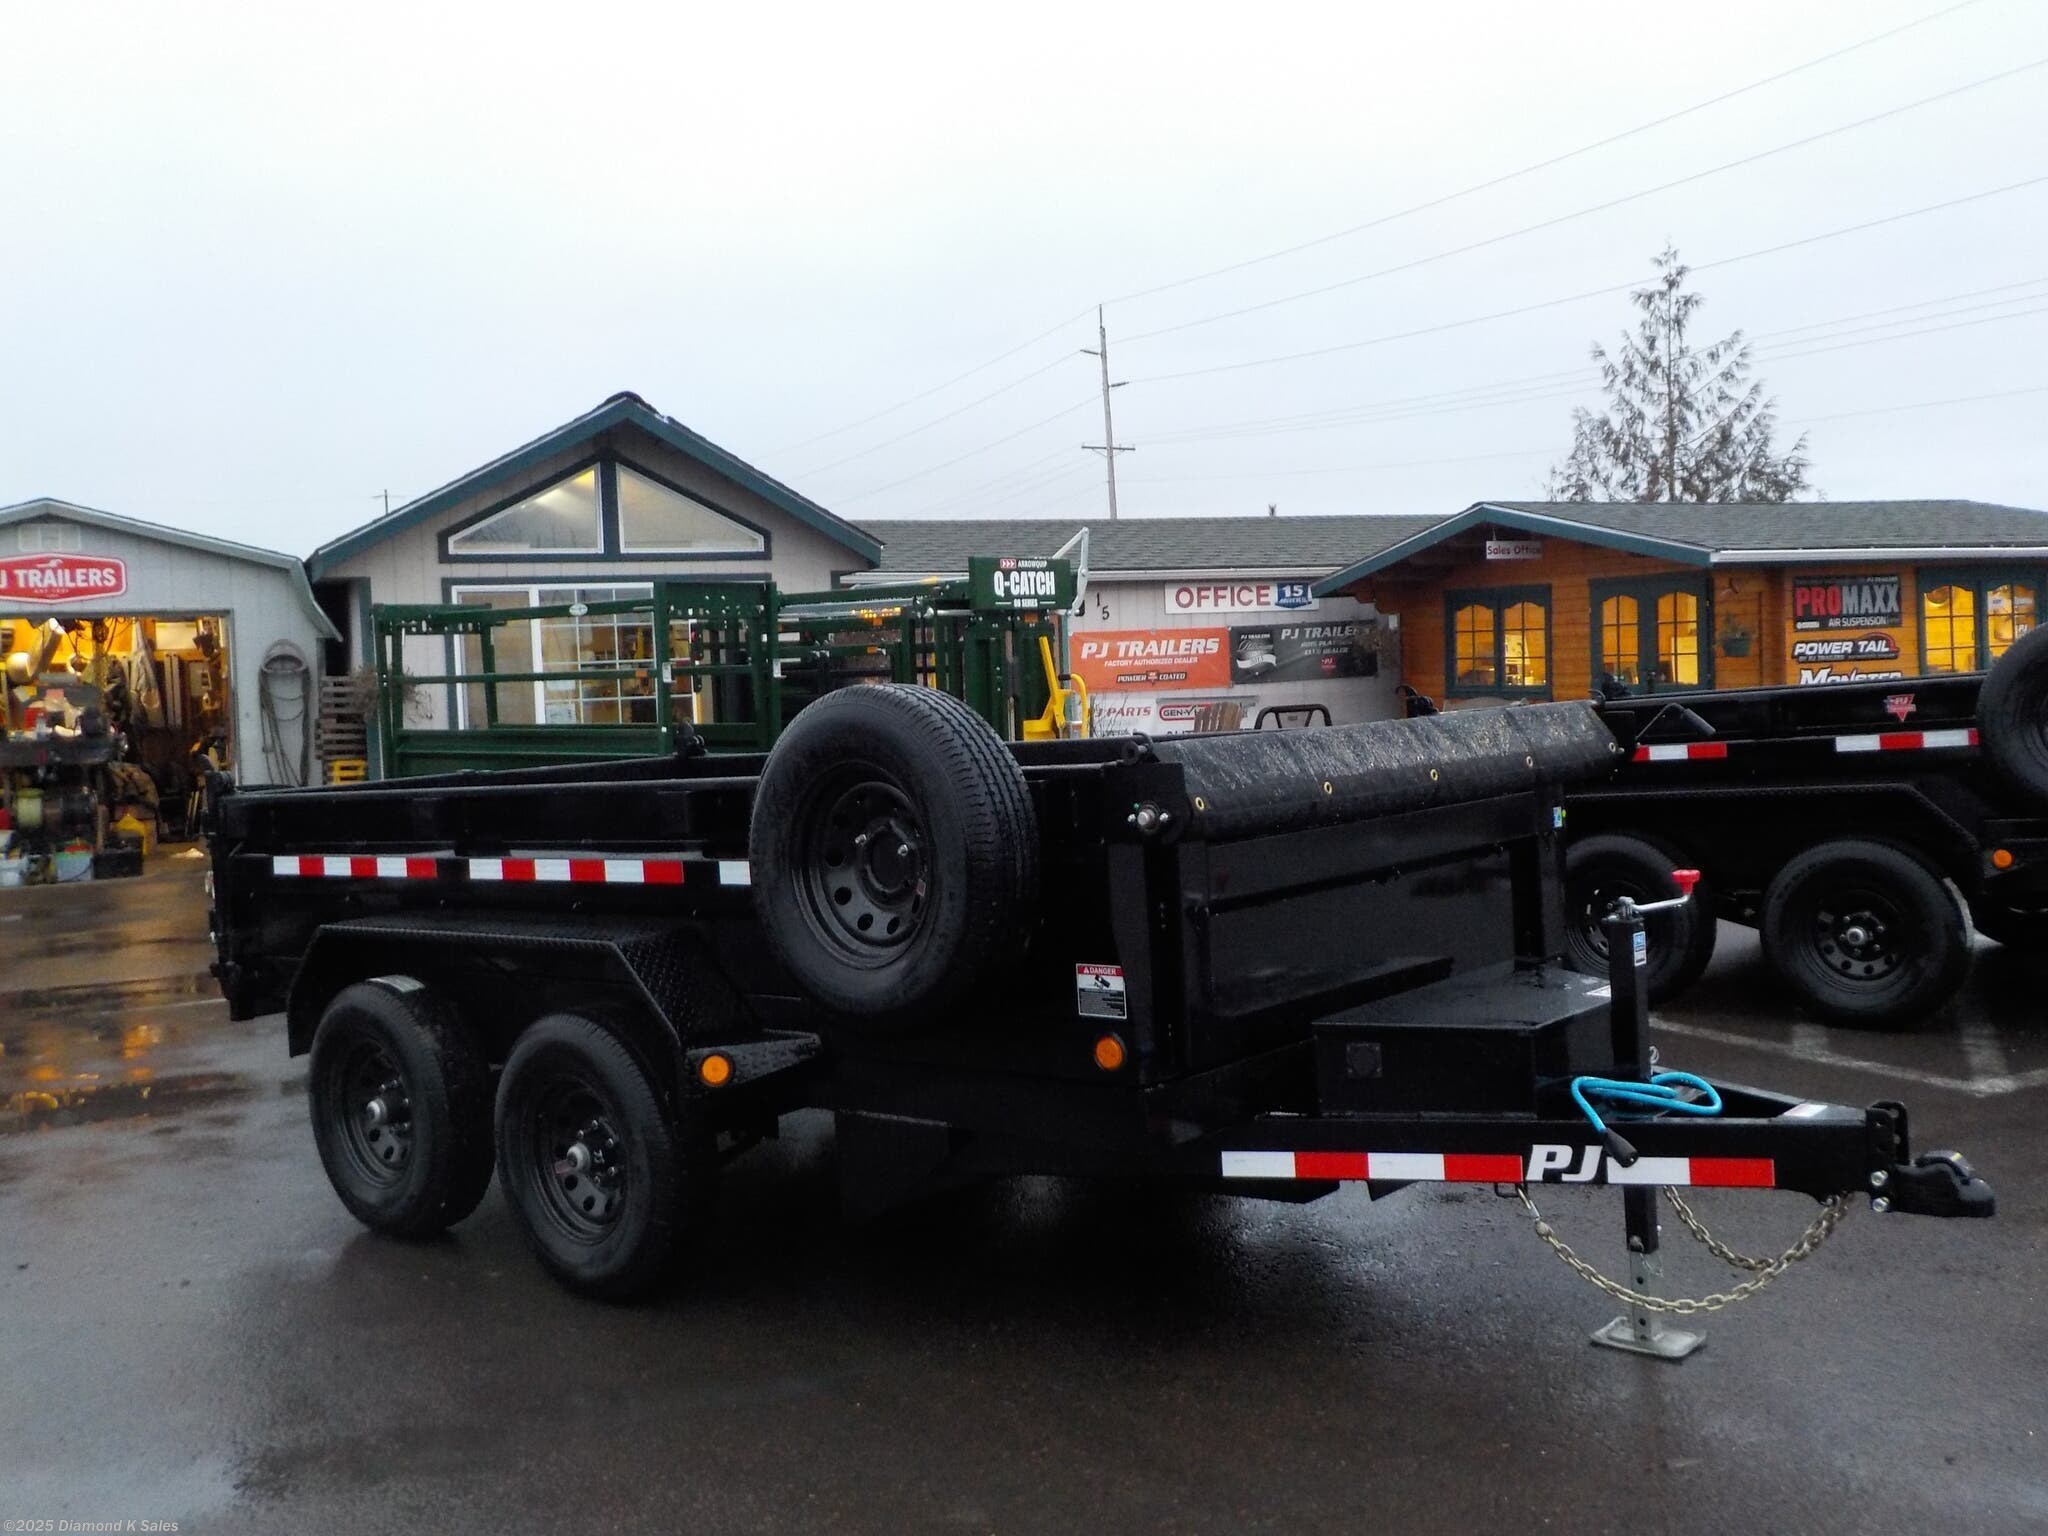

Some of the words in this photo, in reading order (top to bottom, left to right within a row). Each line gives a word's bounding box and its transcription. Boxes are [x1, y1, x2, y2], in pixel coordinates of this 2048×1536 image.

[1487, 545, 1511, 555] Sales
[14, 567, 116, 588] TRAILERS
[993, 571, 1056, 597] Q-CATCH
[1175, 585, 1271, 609] OFFICE
[1282, 584, 1304, 598] 15
[1795, 584, 1900, 616] PROMAXX
[1828, 619, 1841, 627] AIR
[1842, 617, 1887, 627] SUSPENSION
[1281, 628, 1299, 640] PJ
[1081, 641, 1110, 659] PJ
[1117, 637, 1220, 657] TRAILERS
[1794, 641, 1854, 656] POWER
[1857, 640, 1890, 653] TAIL
[1104, 658, 1133, 667] FACTORY
[1133, 657, 1173, 666] AUTHORIZED
[1173, 656, 1198, 664] DEALER
[1117, 675, 1147, 683] POWDER
[1159, 673, 1186, 681] COATED
[1106, 706, 1151, 718] PARTS
[1089, 966, 1117, 975] DANGER
[1526, 1144, 1603, 1182] PJ
